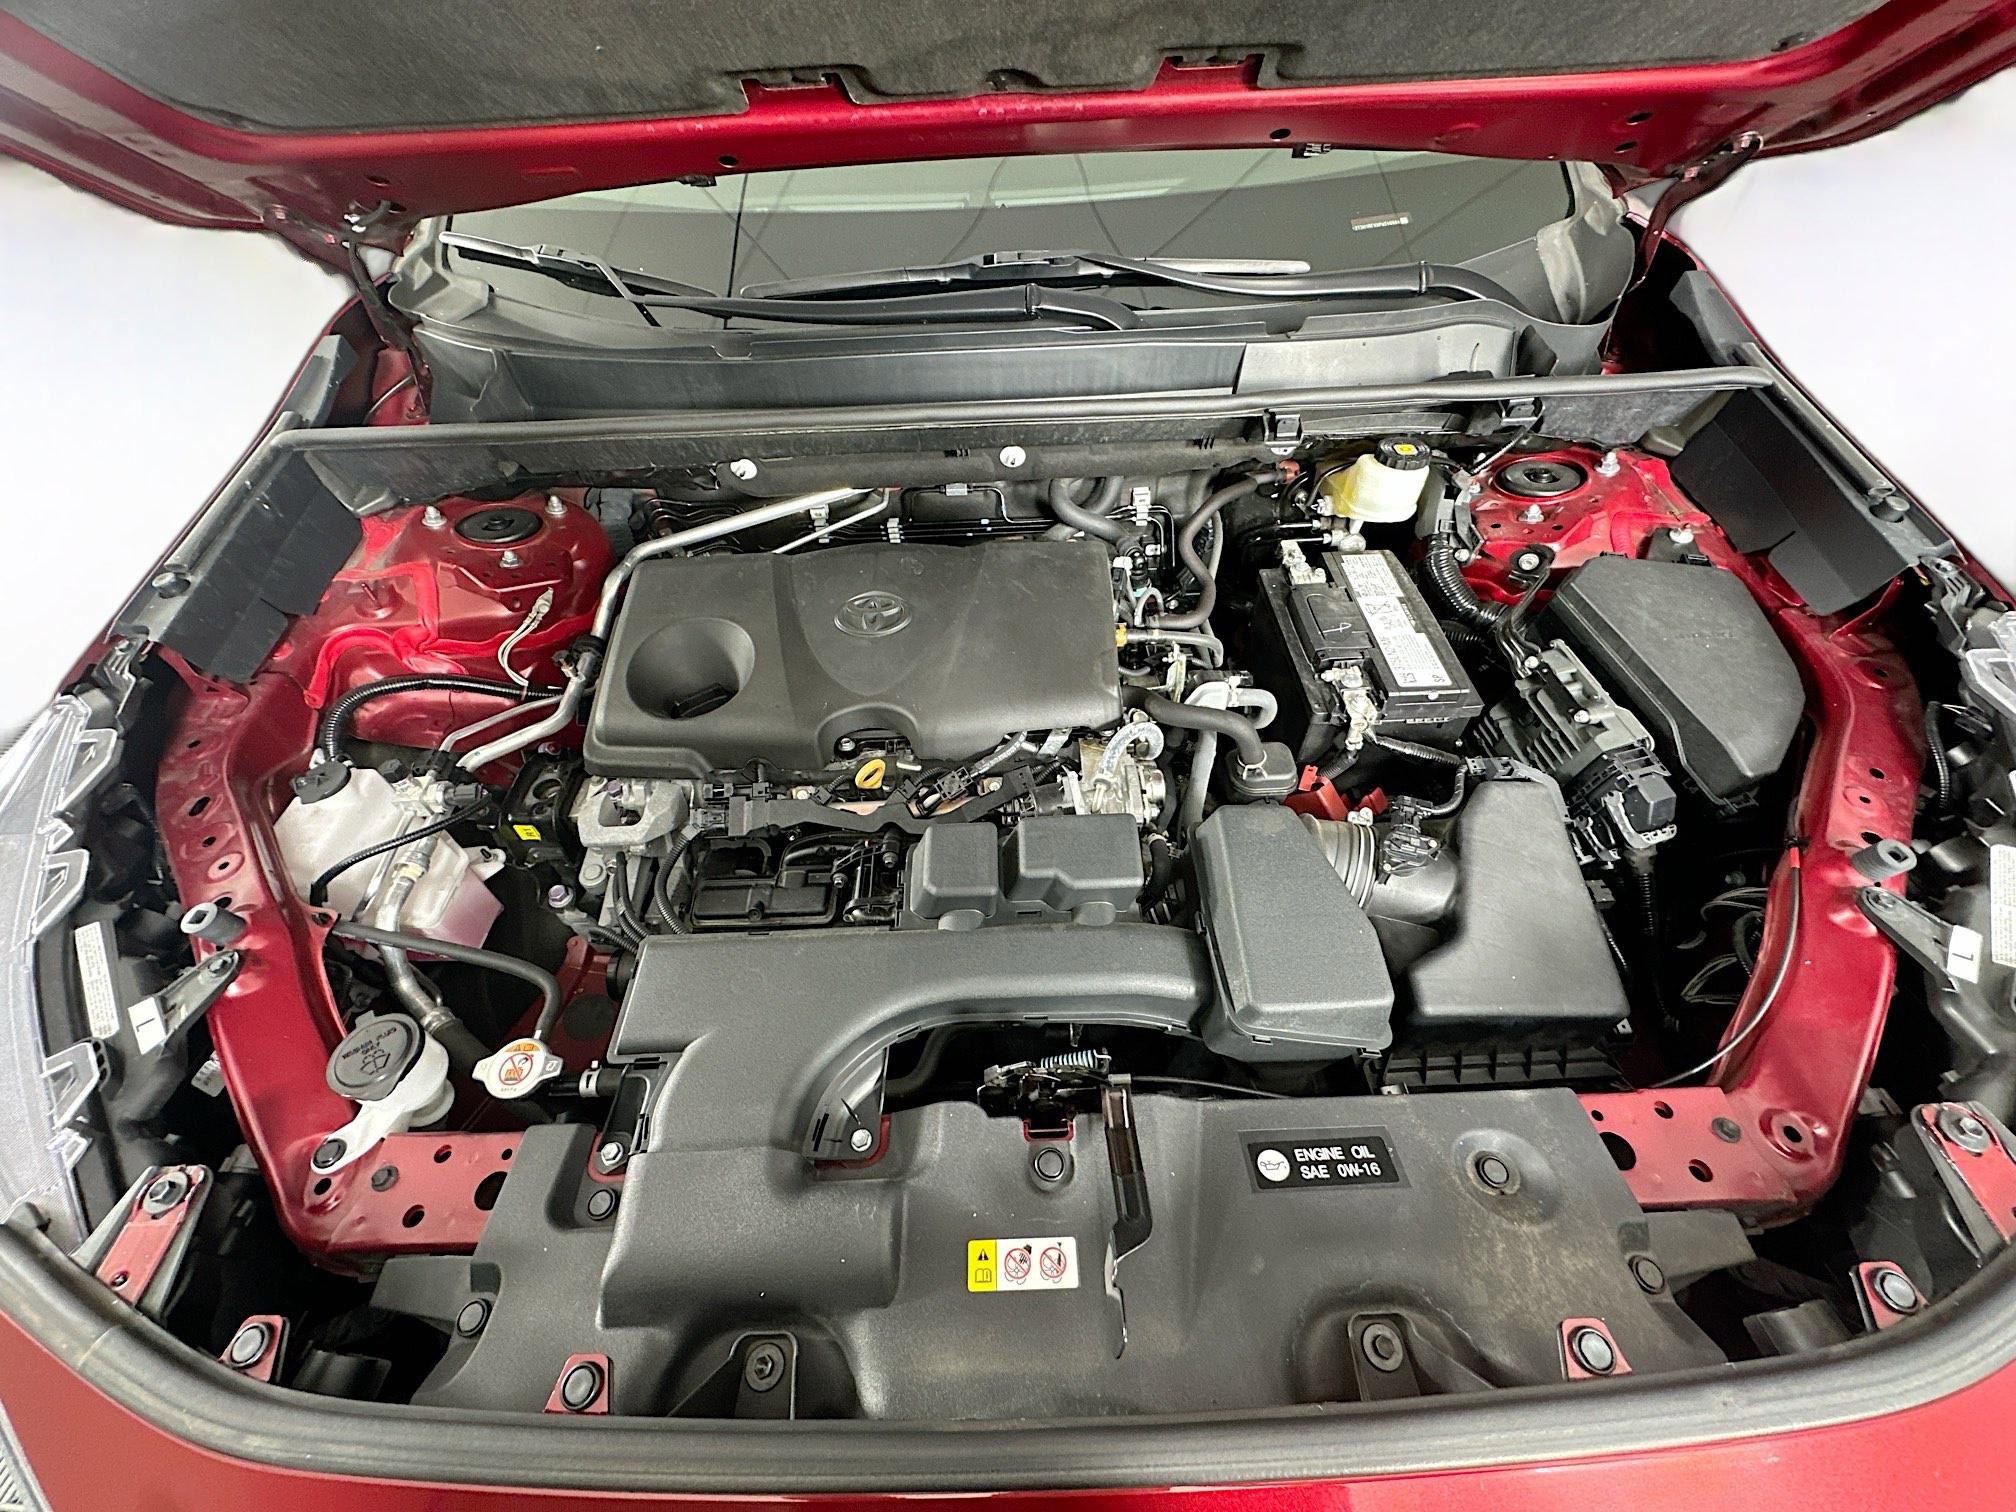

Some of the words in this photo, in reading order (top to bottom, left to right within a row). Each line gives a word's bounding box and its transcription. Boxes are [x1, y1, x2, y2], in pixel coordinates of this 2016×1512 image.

[1293, 1146, 1346, 1162] ENGINE
[1350, 1144, 1376, 1160] OIL
[1299, 1164, 1331, 1180] SAE
[1336, 1161, 1382, 1178] 0W-16
